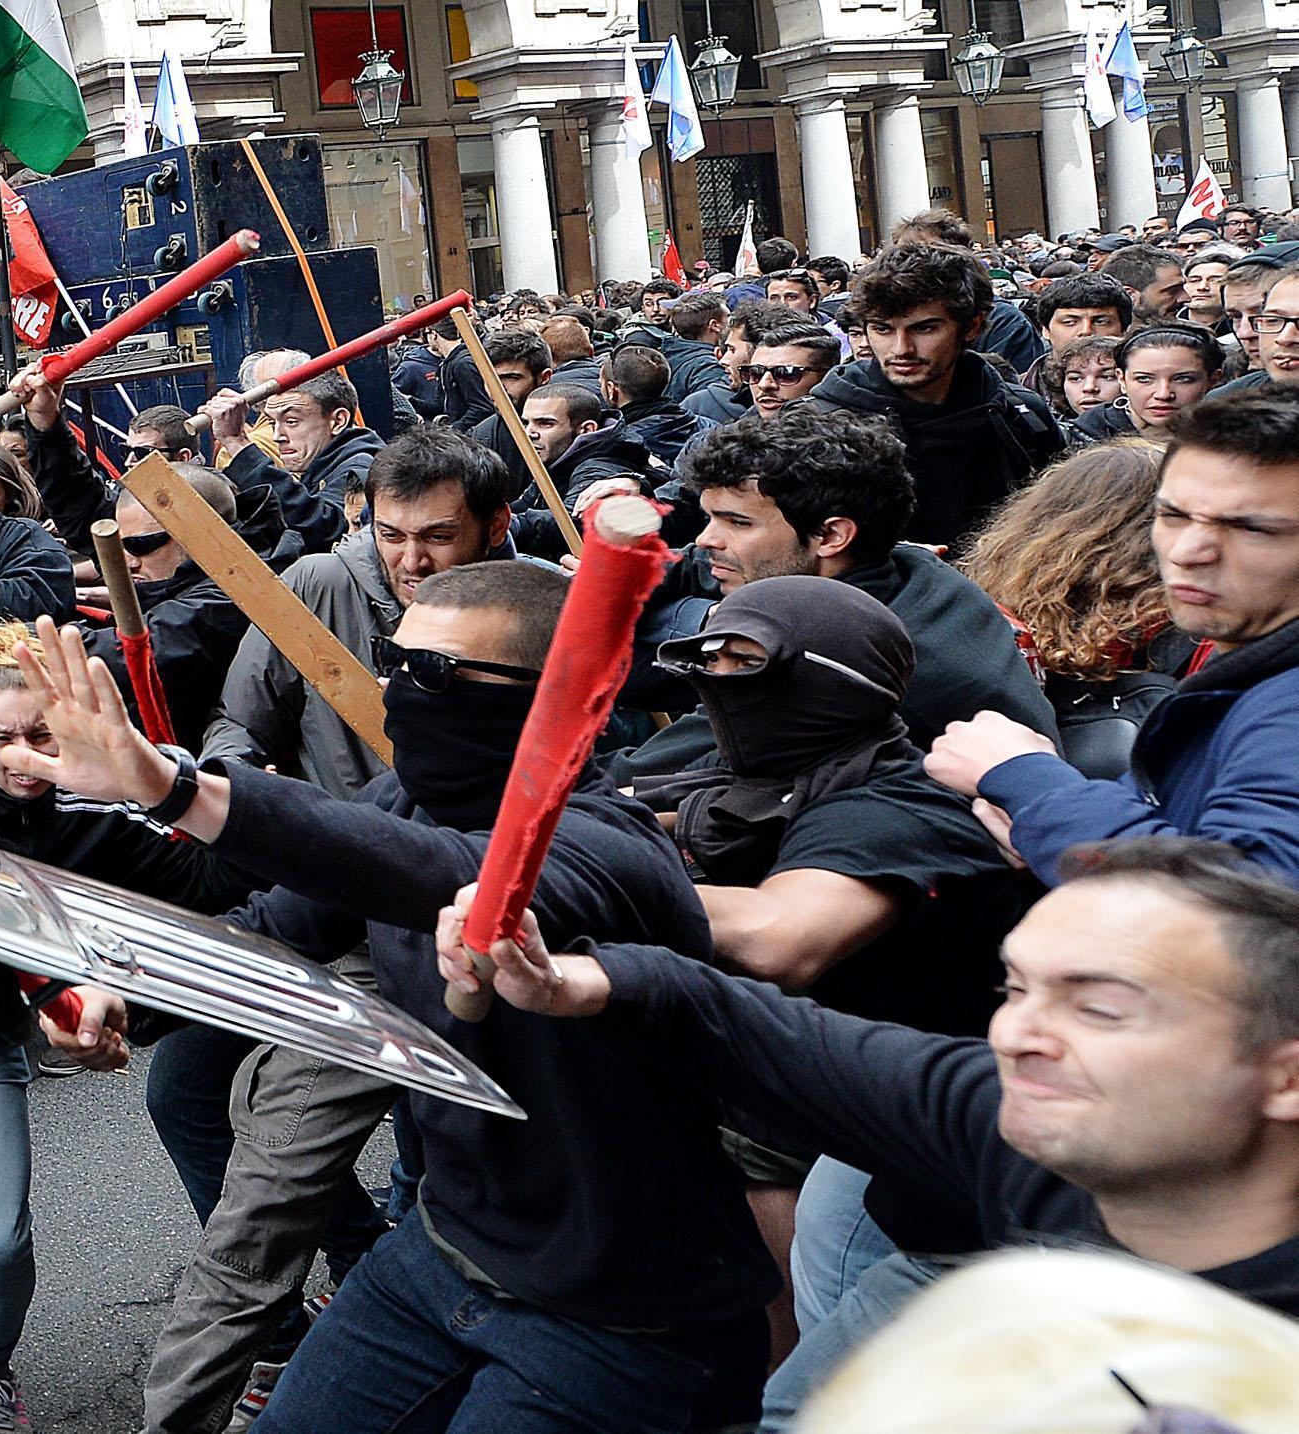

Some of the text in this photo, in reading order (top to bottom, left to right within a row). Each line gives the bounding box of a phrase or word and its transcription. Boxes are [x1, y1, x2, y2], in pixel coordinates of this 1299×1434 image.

[171, 200, 187, 215] 2
[102, 286, 113, 308] 6
[12, 292, 51, 340] RE
